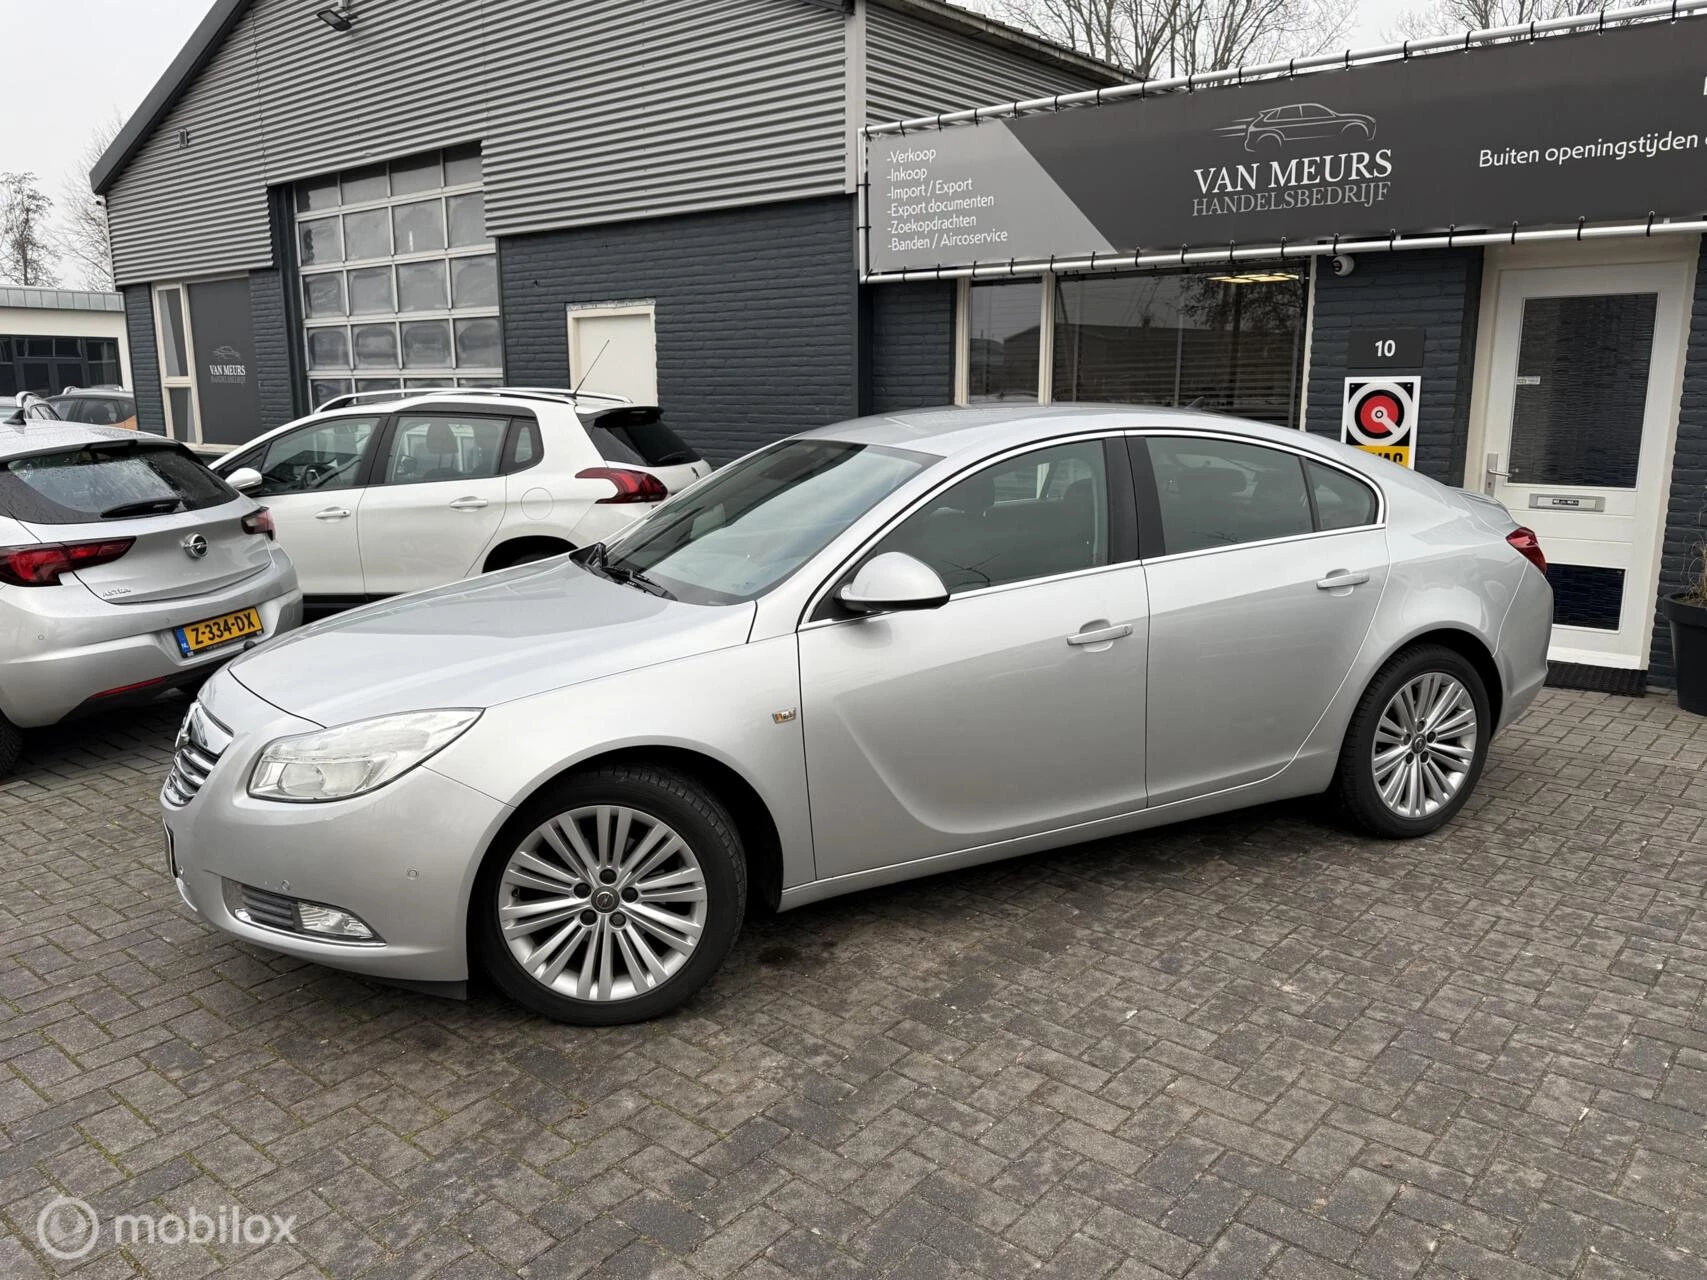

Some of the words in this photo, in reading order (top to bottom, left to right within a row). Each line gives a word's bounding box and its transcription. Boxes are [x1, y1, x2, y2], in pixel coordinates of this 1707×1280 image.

[887, 148, 936, 163] -Verkoop
[1479, 147, 1539, 167] Buiten
[1545, 131, 1698, 165] openingstijden
[886, 166, 928, 182] -Inkoop
[1194, 163, 1260, 194] VAN
[1268, 149, 1393, 188] MEURS
[887, 184, 926, 201] -Import
[935, 178, 973, 197] Export
[1192, 181, 1392, 217] HANDELSBEDRIJF
[887, 201, 926, 218] -Export
[928, 194, 995, 213] documenten
[888, 214, 977, 234] -Zoekopdrachten
[887, 235, 930, 252] -Banden
[940, 228, 1009, 248] Aircoservice
[1375, 339, 1396, 357] 10
[209, 364, 222, 375] VAN
[223, 364, 246, 375] MEURS
[191, 611, 256, 646] Z-334-DX
